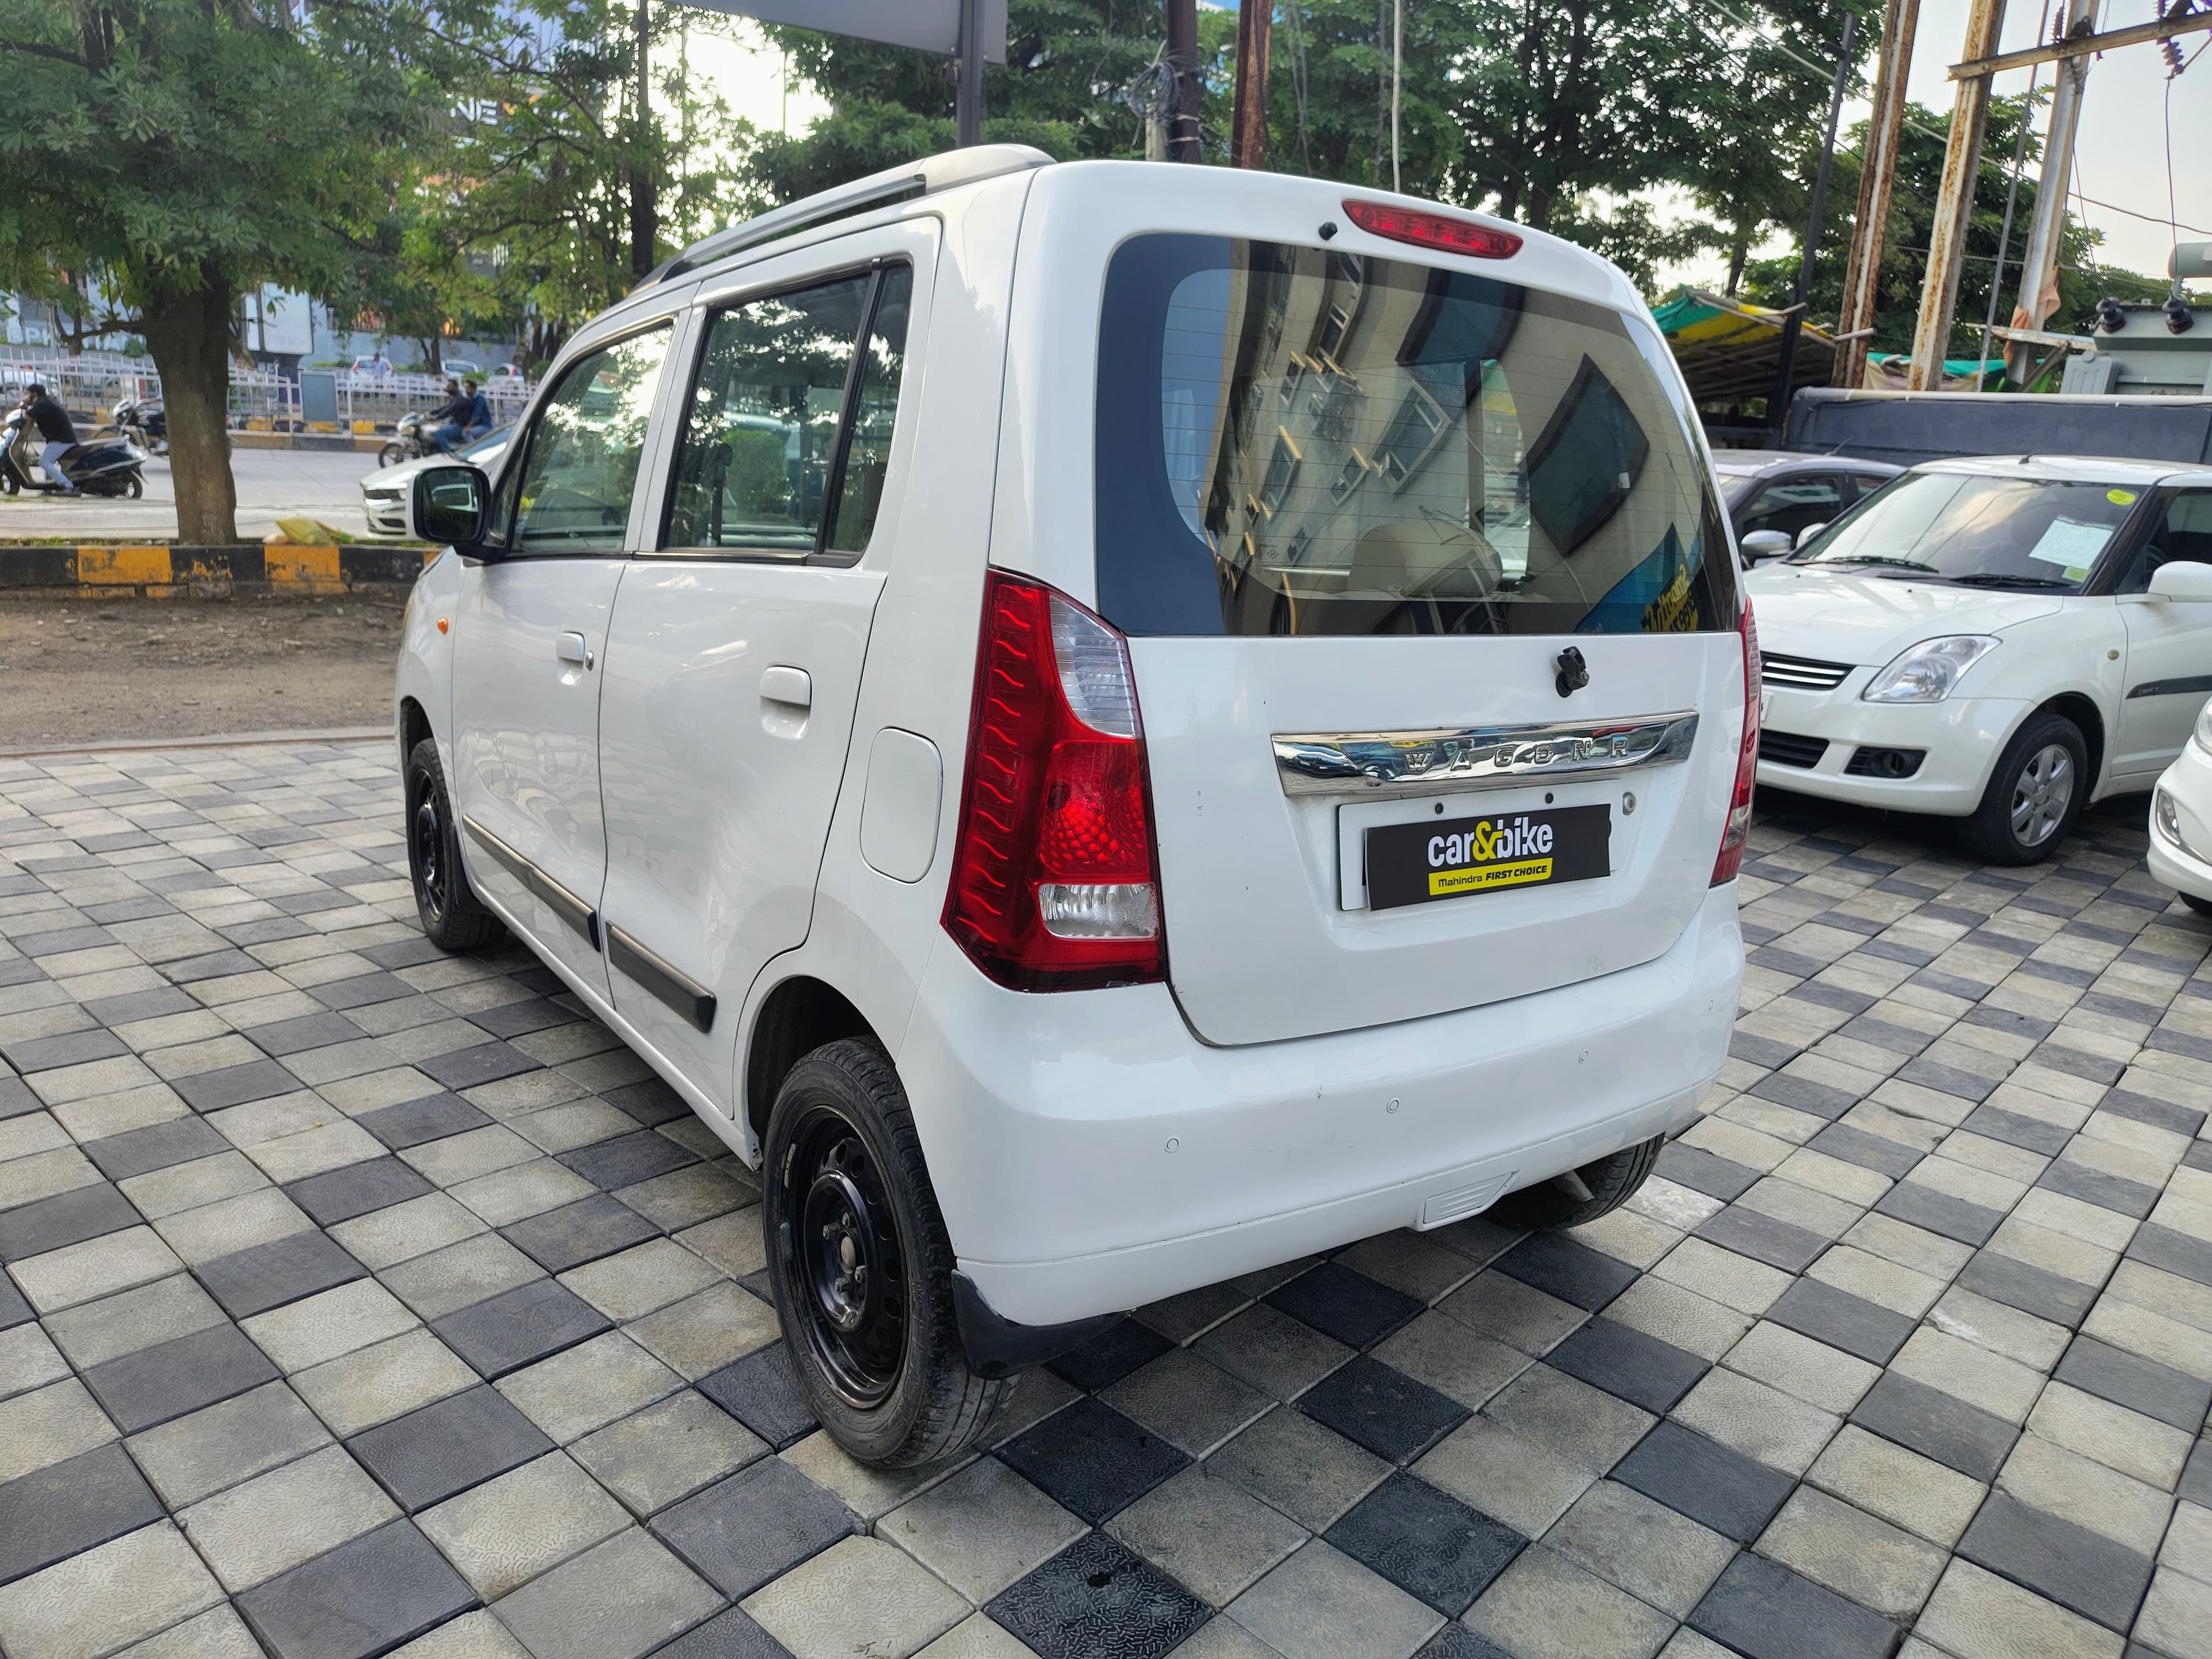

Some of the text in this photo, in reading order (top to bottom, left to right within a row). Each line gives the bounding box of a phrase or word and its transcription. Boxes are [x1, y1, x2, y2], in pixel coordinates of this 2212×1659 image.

[1427, 816, 1553, 868] car&bike
[1438, 865, 1547, 887] Mahindra FIRST CHOICE
